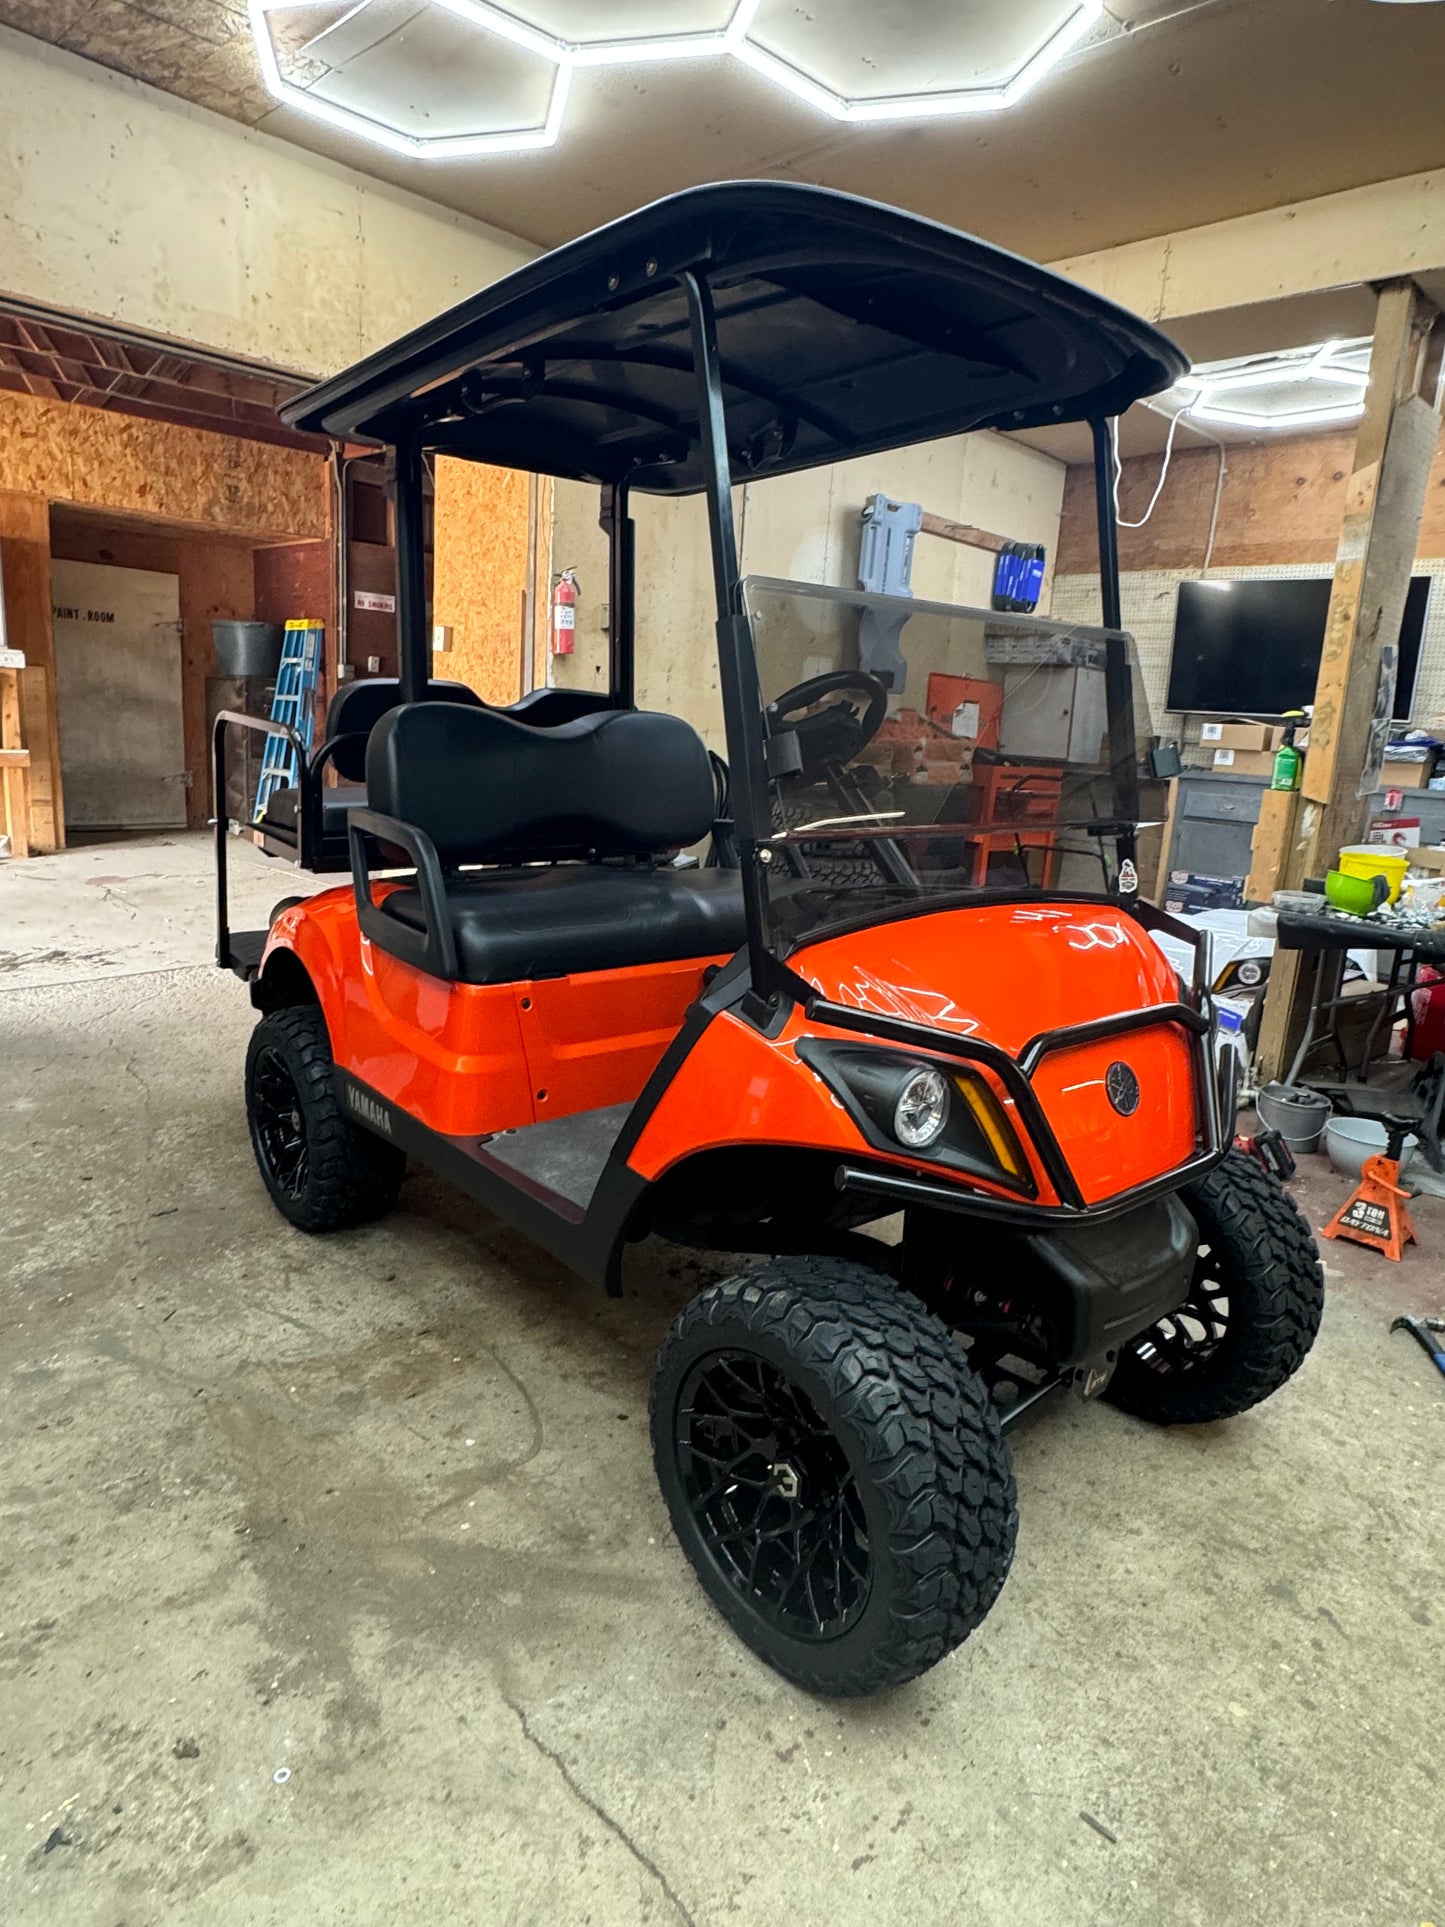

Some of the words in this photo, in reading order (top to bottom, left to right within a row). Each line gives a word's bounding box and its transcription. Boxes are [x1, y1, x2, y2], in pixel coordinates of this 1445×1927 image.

[87, 610, 115, 623] ROOM
[347, 1084, 392, 1136] YAMAHA
[1352, 1201, 1367, 1219] 3
[1366, 1206, 1386, 1220] TON
[1339, 1216, 1390, 1237] DAYTONA
